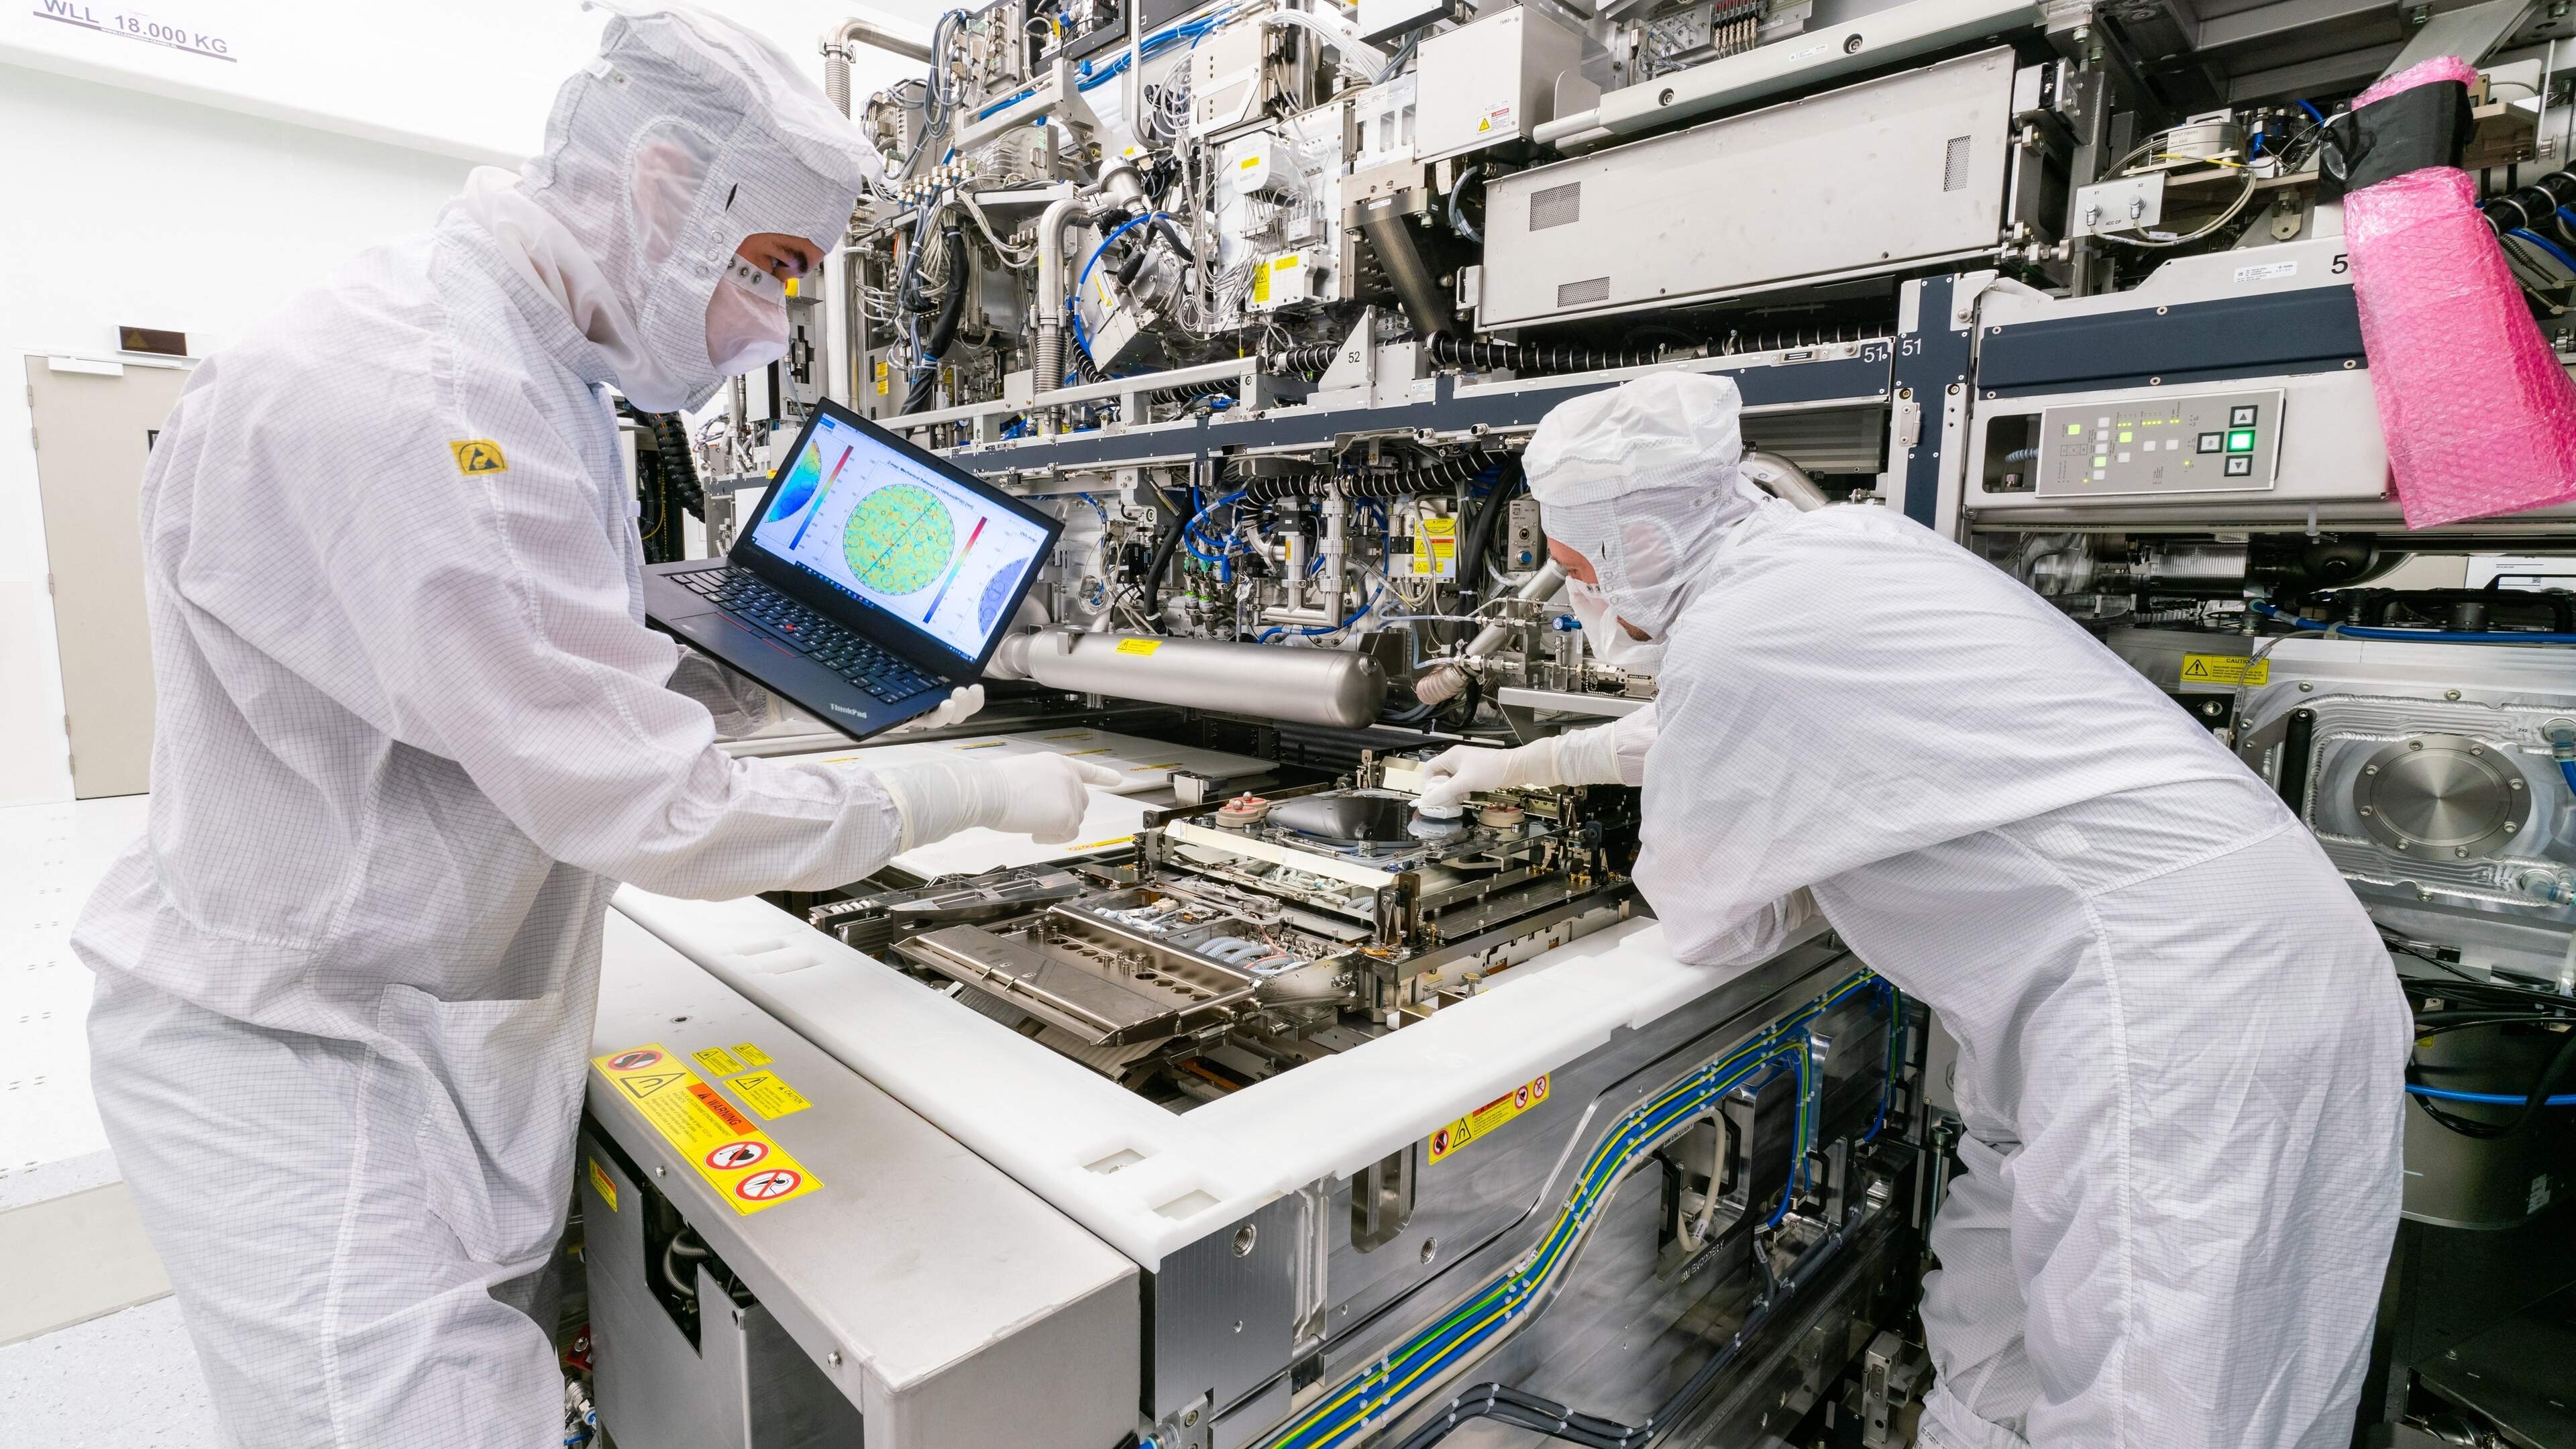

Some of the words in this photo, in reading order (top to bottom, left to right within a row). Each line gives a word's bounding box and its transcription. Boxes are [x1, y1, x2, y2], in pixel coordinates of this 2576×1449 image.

[44, 0, 99, 24] WLL
[115, 15, 186, 44] 18.000
[195, 33, 228, 54] KG
[1864, 345, 1883, 363] 51
[1901, 338, 1921, 356] 51
[1348, 351, 1360, 364] 52
[828, 702, 868, 719] ThinkPad
[784, 1087, 805, 1105] CAUTION
[707, 1098, 741, 1126] WARNING
[1690, 1243, 1719, 1273] ENCODER
